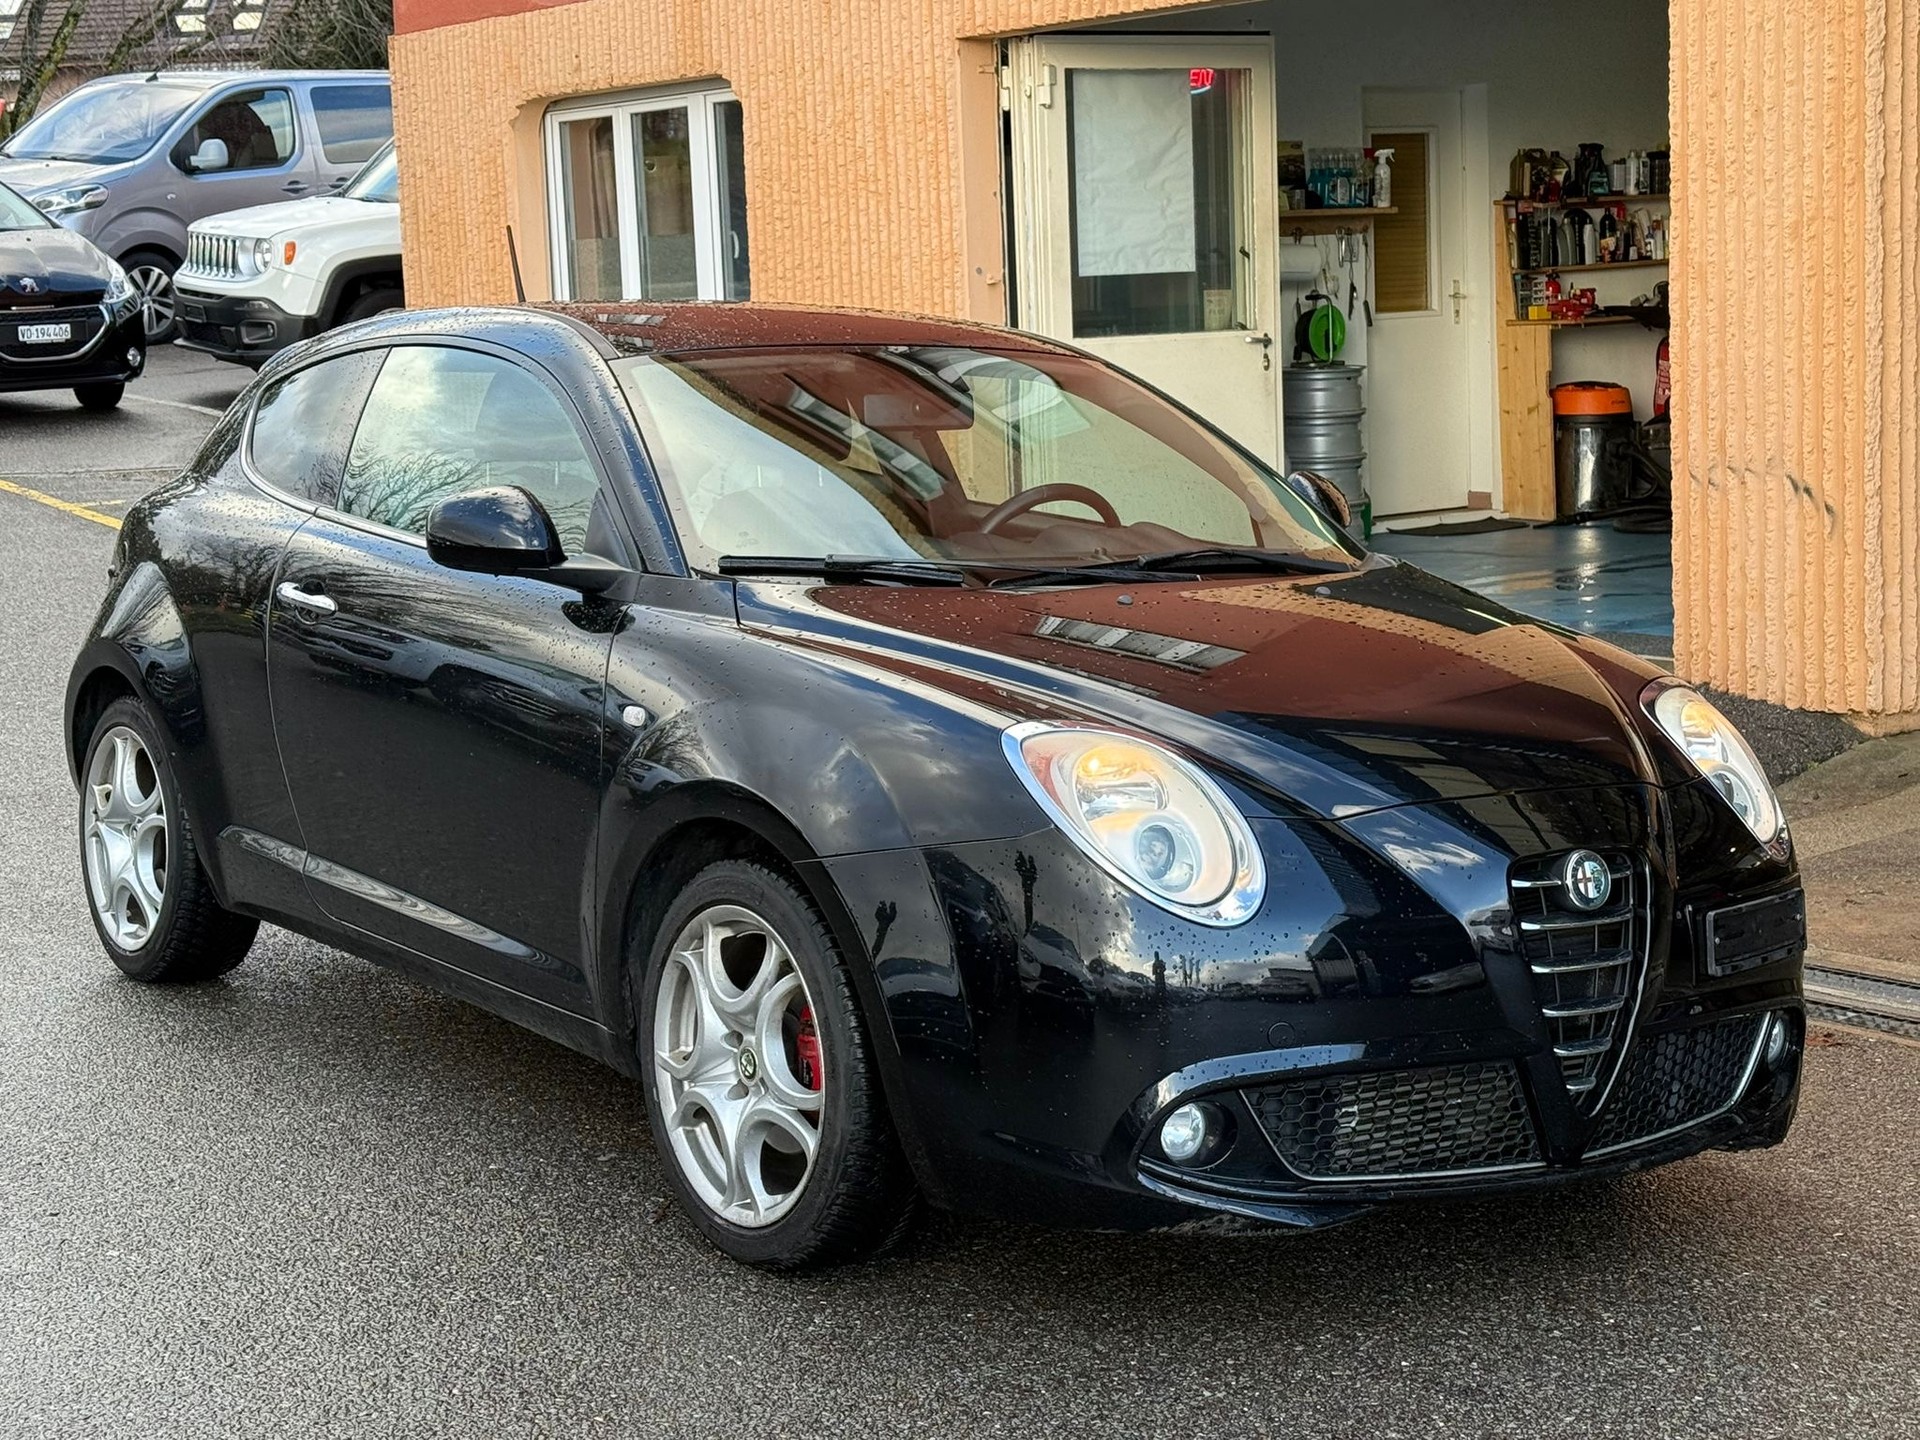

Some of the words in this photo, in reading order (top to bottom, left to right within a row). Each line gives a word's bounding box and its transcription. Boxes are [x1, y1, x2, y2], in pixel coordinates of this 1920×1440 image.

[1189, 68, 1214, 87] EN
[20, 328, 32, 339] VD
[35, 326, 69, 338] 194406
